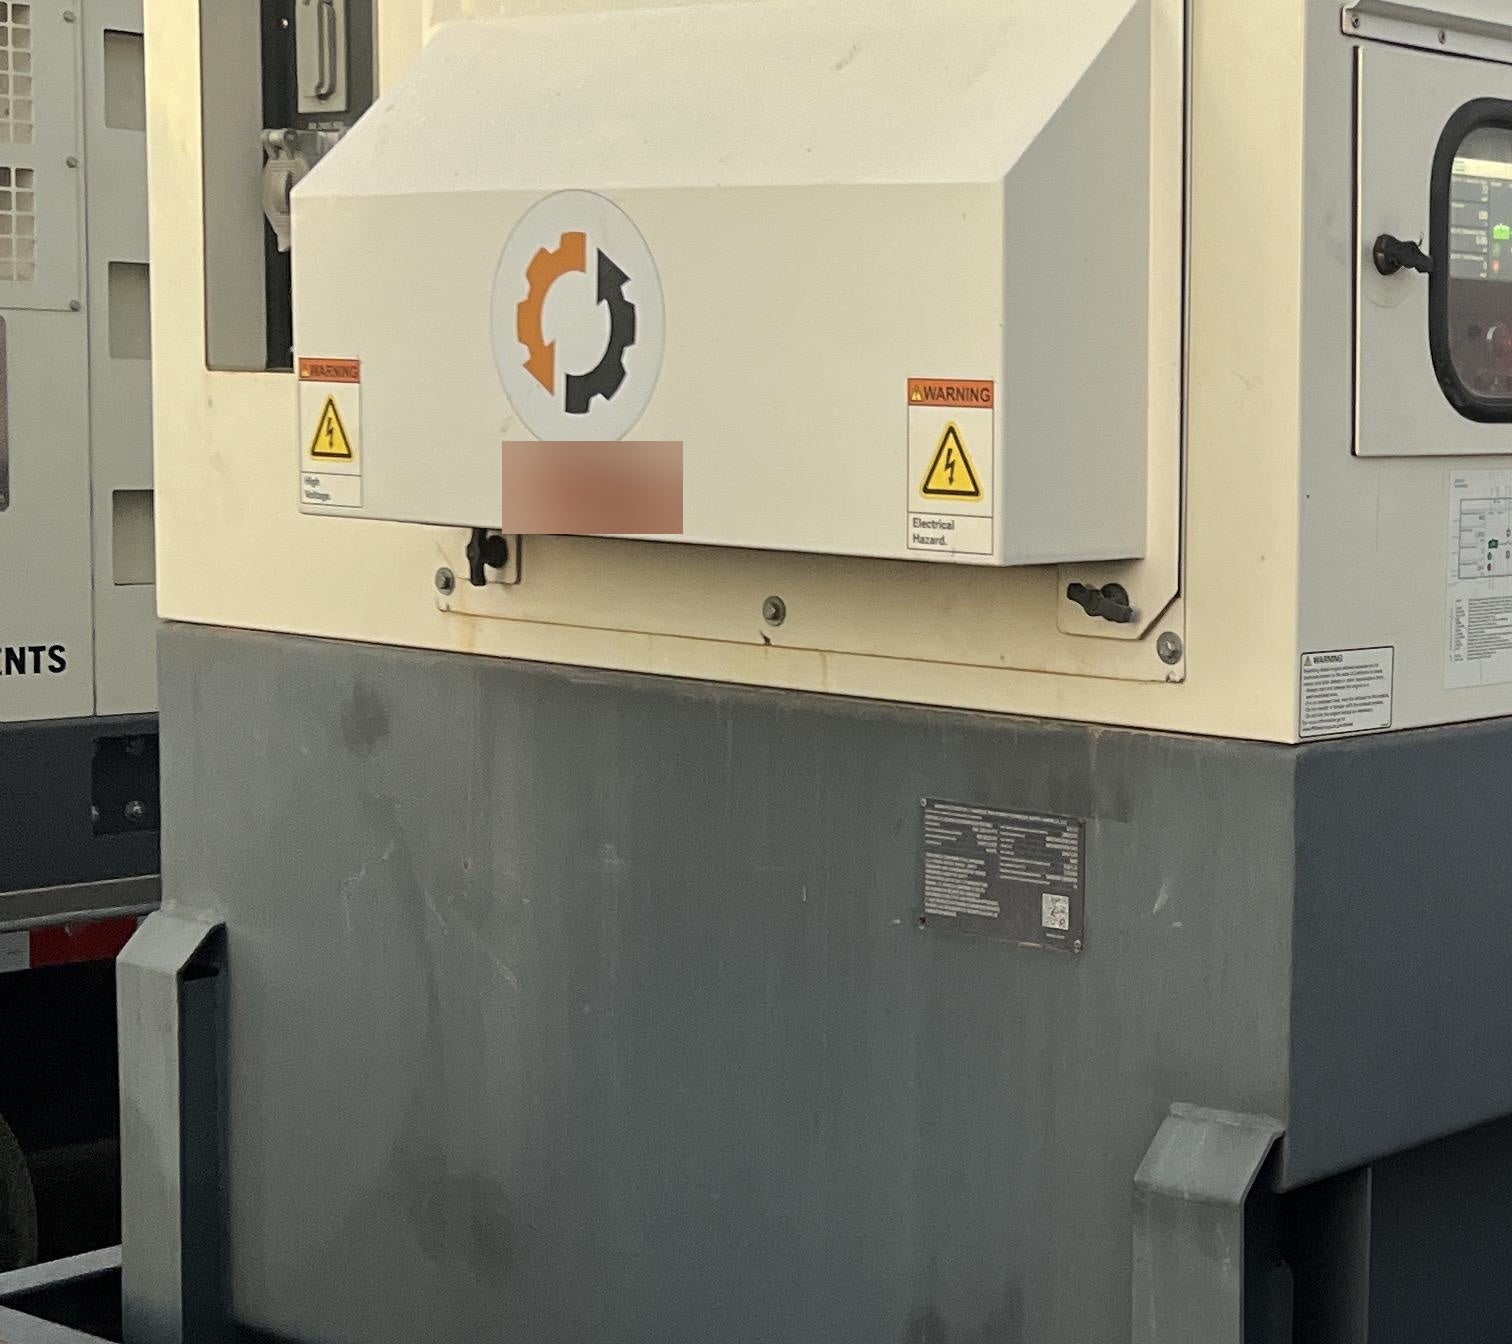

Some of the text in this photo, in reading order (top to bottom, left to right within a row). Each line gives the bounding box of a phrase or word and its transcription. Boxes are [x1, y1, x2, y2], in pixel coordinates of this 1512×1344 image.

[310, 364, 359, 379] WARNING
[923, 386, 991, 403] WARNING
[912, 516, 955, 531] Electrical
[0, 644, 67, 676] NTS
